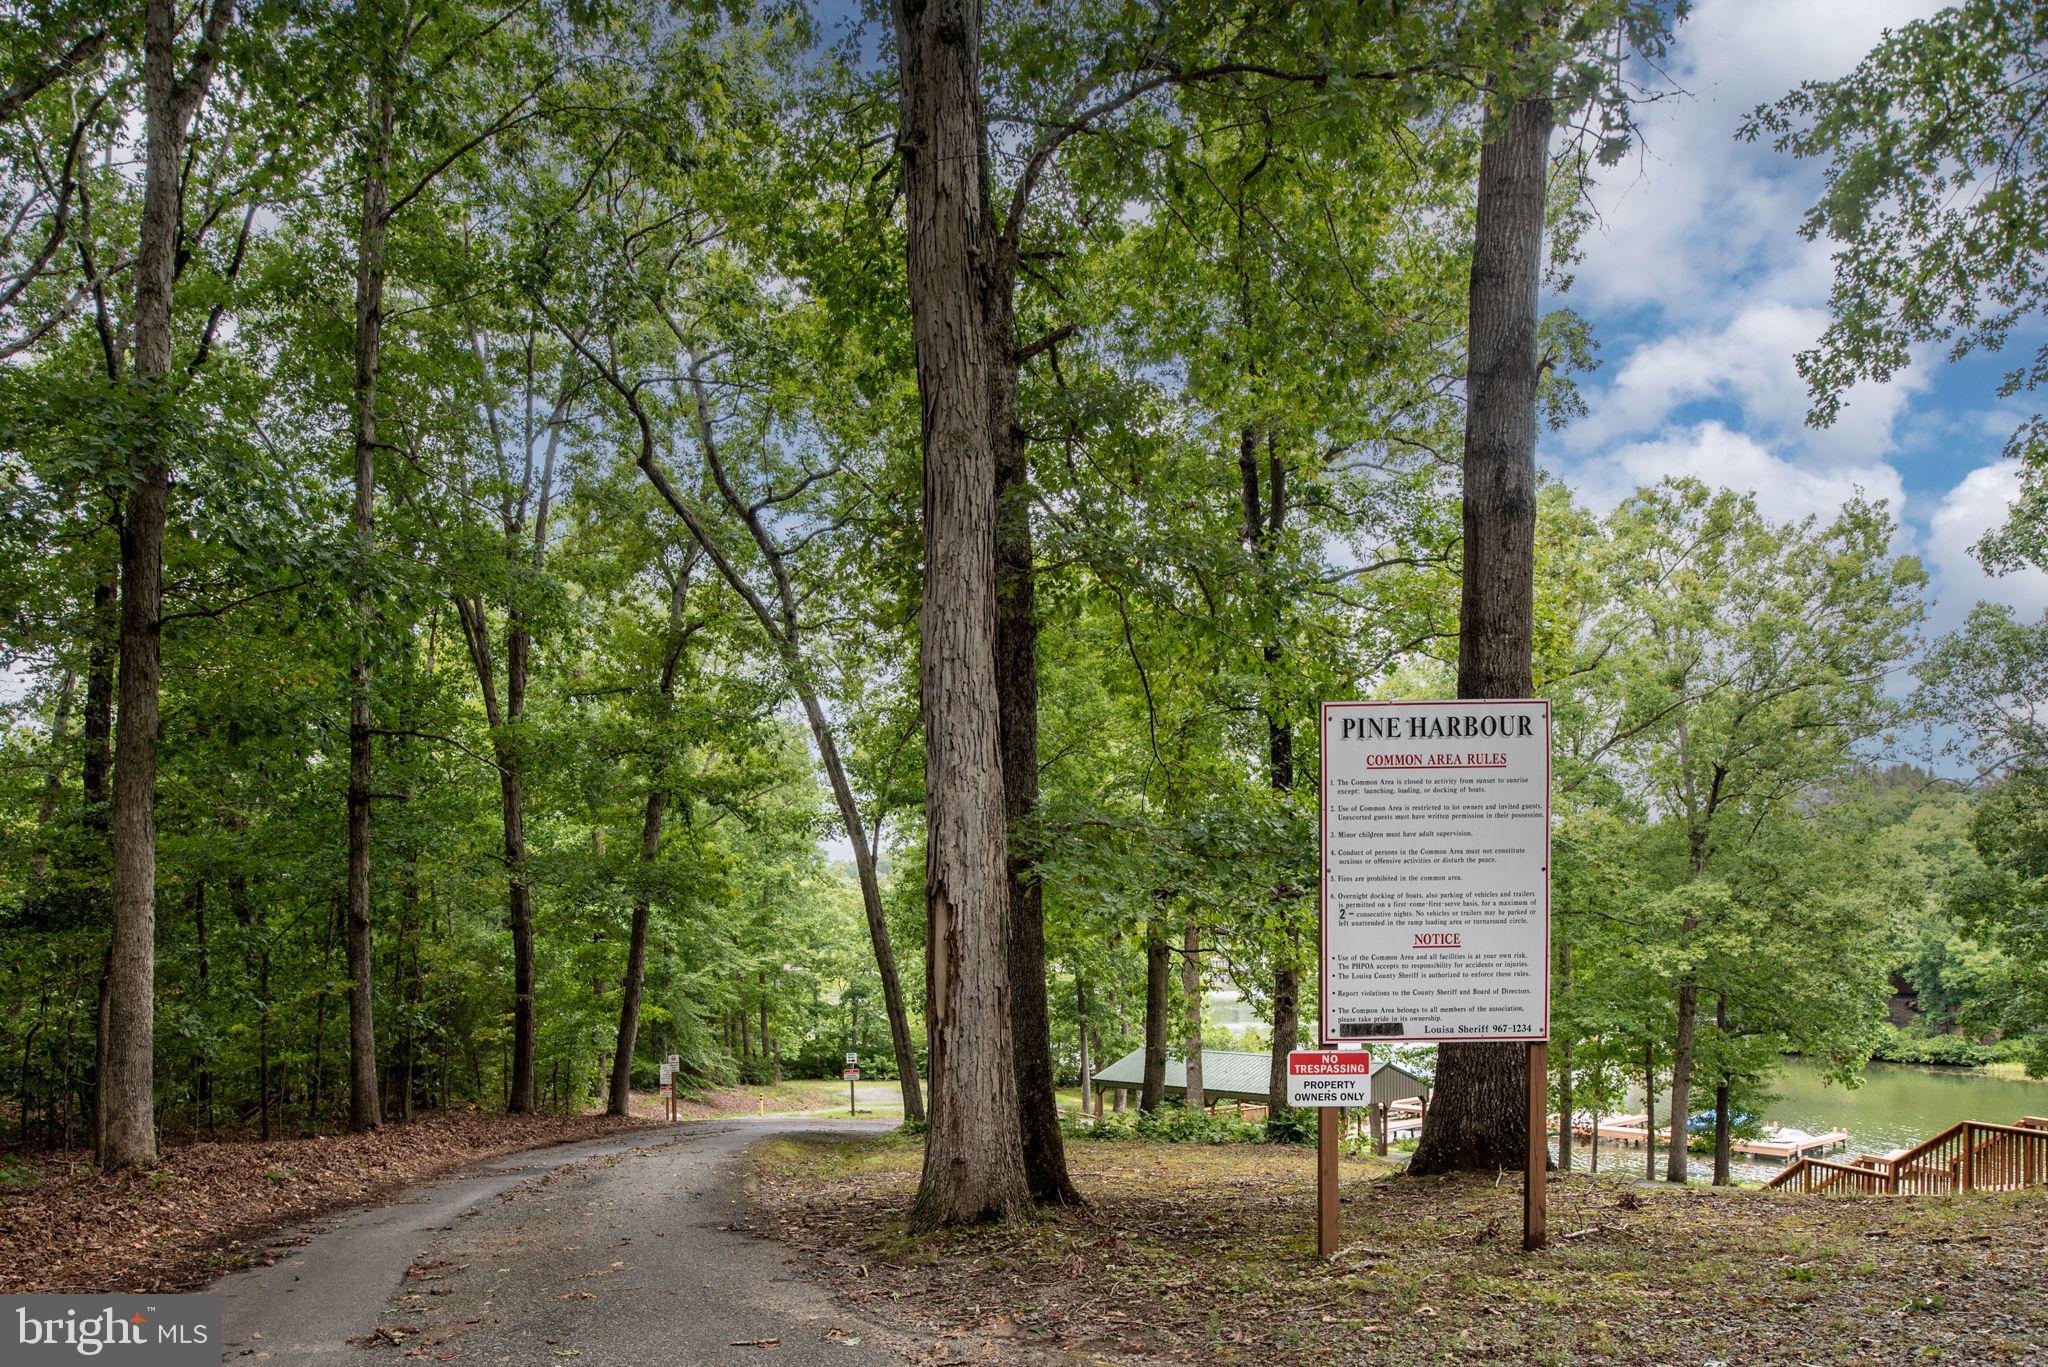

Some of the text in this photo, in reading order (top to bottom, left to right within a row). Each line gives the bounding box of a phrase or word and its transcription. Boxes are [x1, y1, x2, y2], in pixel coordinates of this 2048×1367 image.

[1342, 715, 1532, 738] PINE HARBOUR
[1366, 754, 1507, 766] COMMON AREA RULES
[1434, 778, 1457, 786] activity
[1432, 785, 1458, 794] docking
[1521, 803, 1542, 811] guests.
[1373, 813, 1393, 822] guests
[1451, 812, 1484, 821] permission
[1511, 811, 1544, 820] possession.
[1436, 830, 1473, 838] supervision.
[1366, 874, 1398, 883] prohibited
[1337, 892, 1368, 901] Overnight
[1369, 892, 1395, 901] docking
[1439, 891, 1464, 900] parking
[1344, 900, 1376, 910] permitted
[1339, 909, 1346, 919] 2
[1393, 910, 1413, 919] nights.
[1507, 908, 1528, 917] parked
[1424, 918, 1448, 927] loading
[1414, 933, 1461, 944] NOTICE
[1376, 962, 1399, 971] accepts
[1411, 961, 1452, 970] responsibility
[1504, 961, 1529, 969] injuries.
[1373, 972, 1396, 980] County
[1337, 989, 1359, 998] Report
[1412, 988, 1435, 997] County
[1396, 1006, 1420, 1015] belongs
[1337, 1015, 1357, 1024] please
[1373, 1015, 1389, 1023] pride
[1409, 1014, 1442, 1023] ownership.
[1424, 1022, 1532, 1033] Louisa Sheriff 967-1234
[1322, 1054, 1338, 1064] NO
[1294, 1064, 1364, 1074] TRESPASSING
[1304, 1081, 1356, 1089] PROPERTY
[1294, 1092, 1364, 1101] OWNERS ONLY
